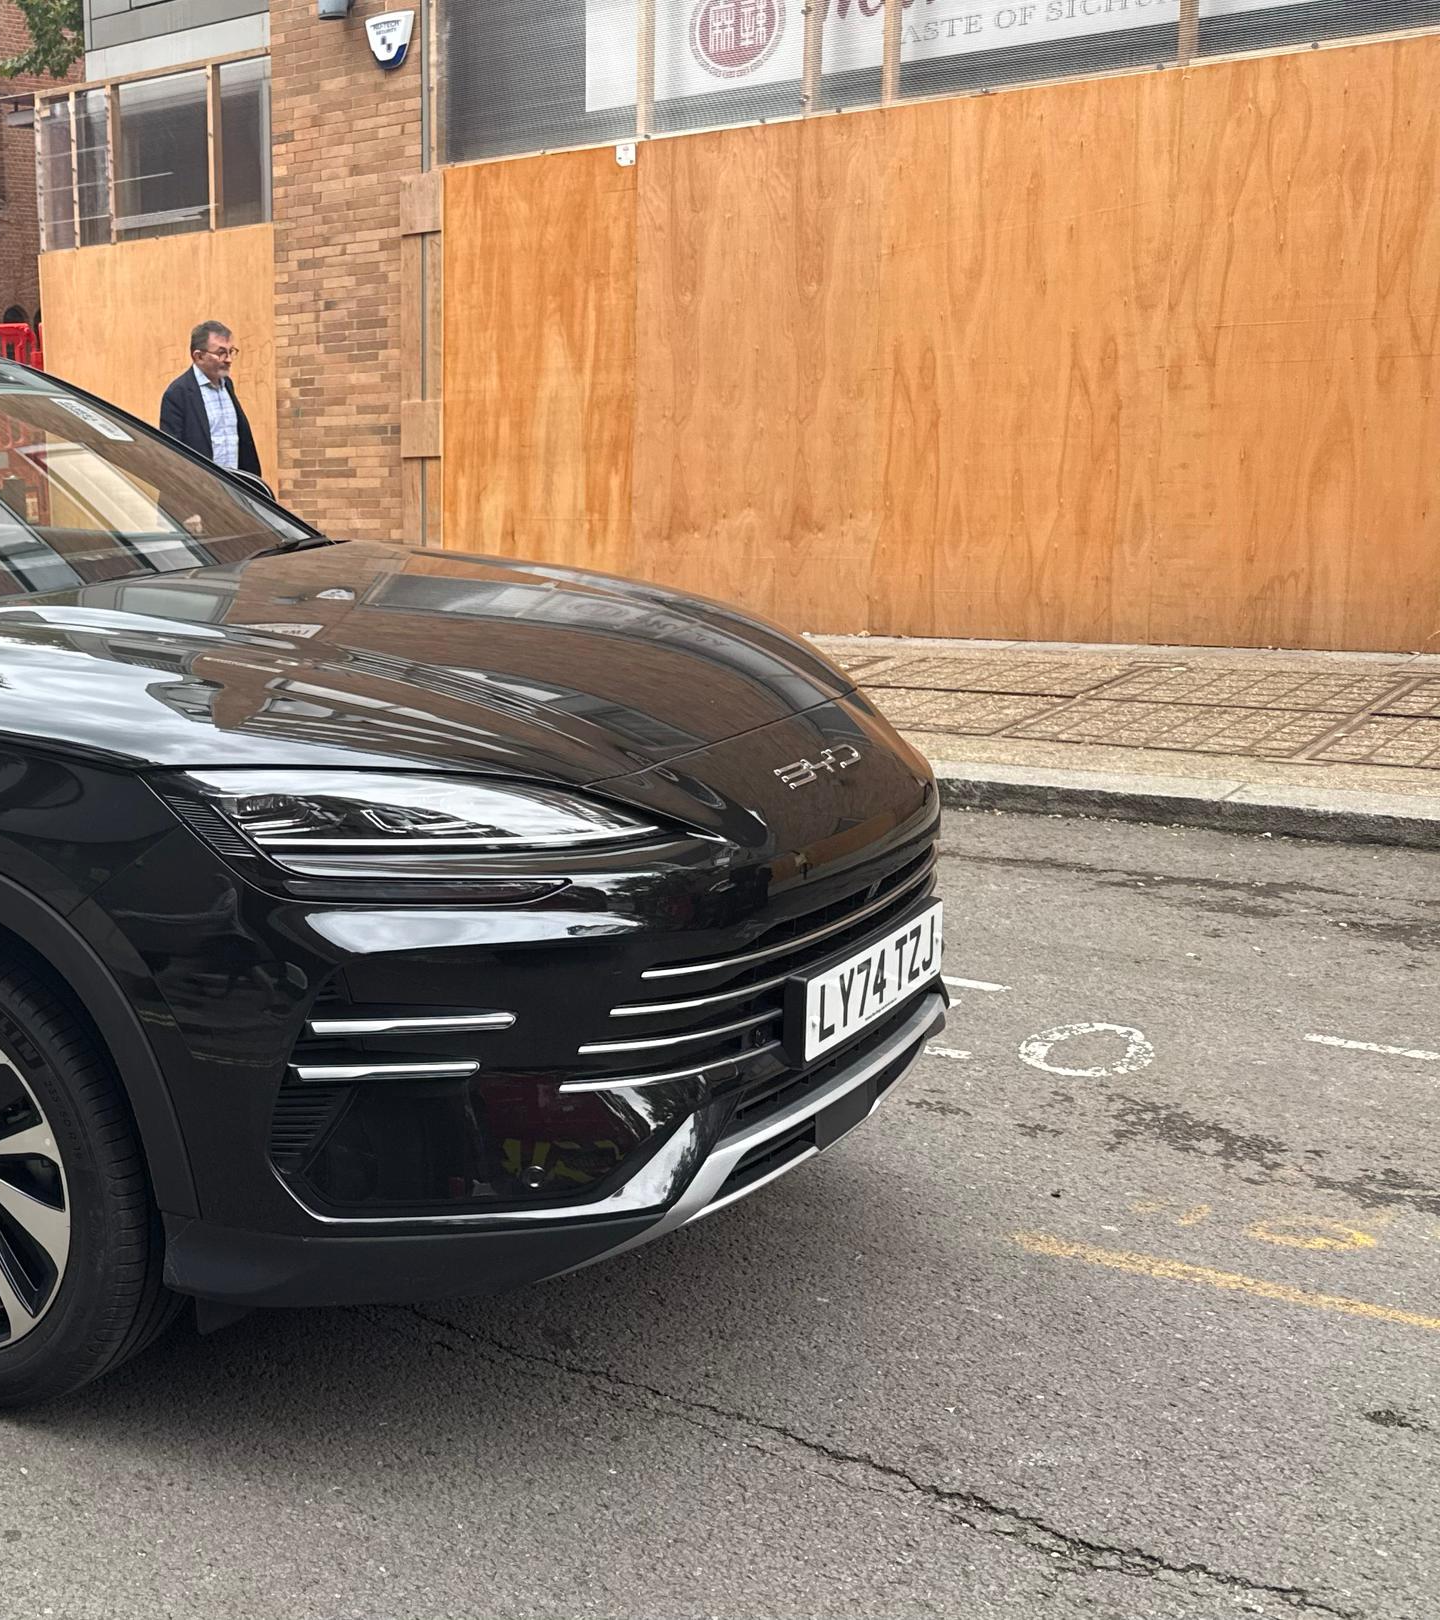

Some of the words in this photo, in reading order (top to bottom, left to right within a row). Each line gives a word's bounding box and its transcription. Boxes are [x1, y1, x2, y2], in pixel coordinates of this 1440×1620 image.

[900, 15, 983, 45] ASTE
[994, 5, 1036, 29] OF
[1045, 0, 1166, 21] SICH
[773, 743, 861, 790] BYD
[819, 948, 887, 1043] LY74
[895, 915, 935, 991] TZJ
